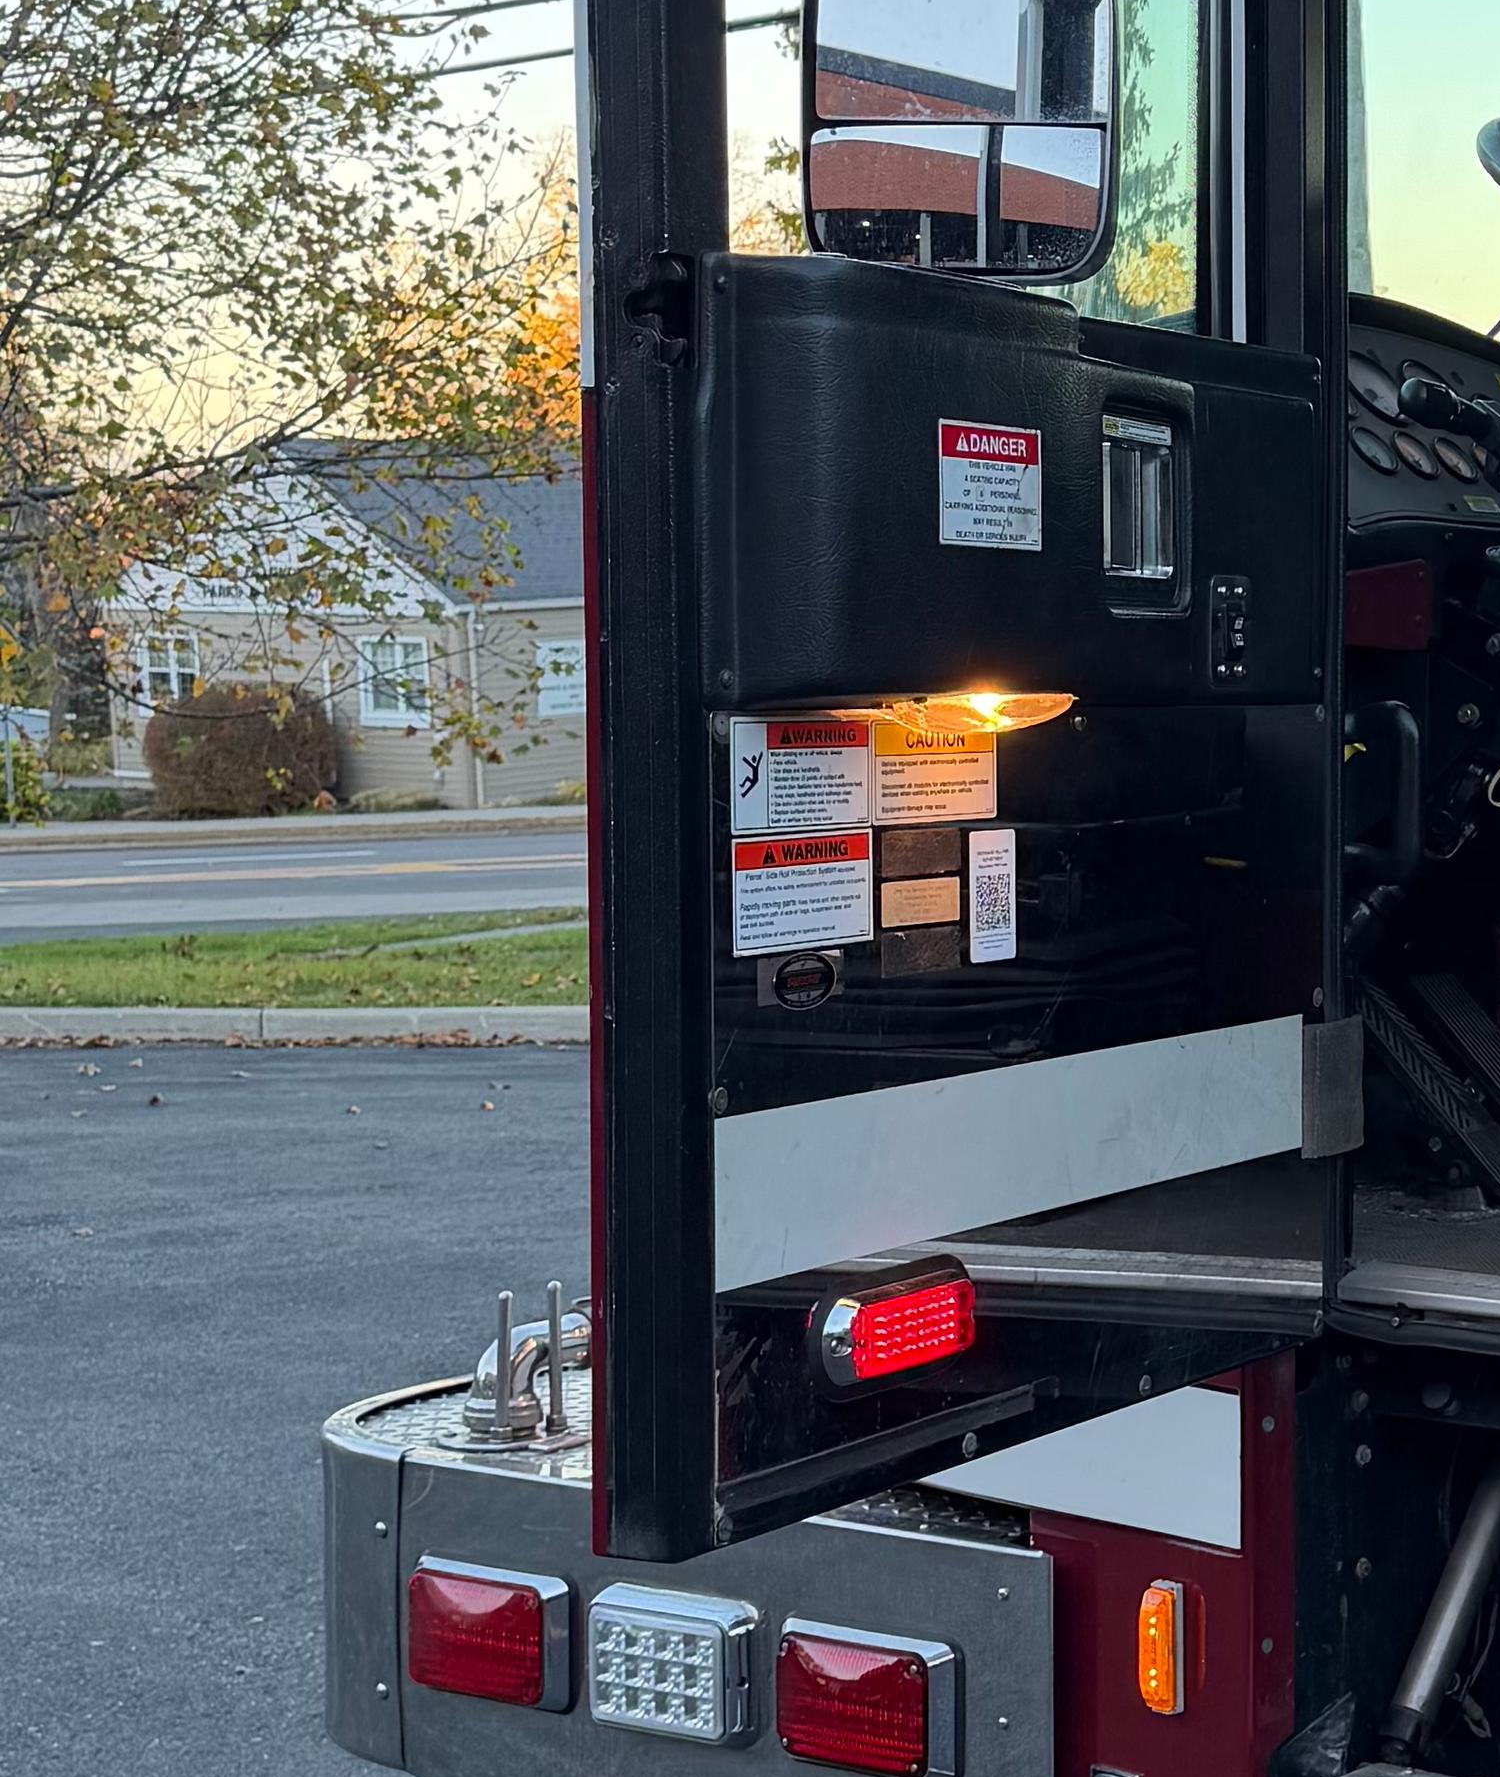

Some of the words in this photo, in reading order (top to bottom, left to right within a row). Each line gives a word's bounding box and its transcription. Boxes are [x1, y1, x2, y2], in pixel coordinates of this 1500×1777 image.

[970, 433, 1026, 457] DANGER
[792, 728, 857, 744] WARNING
[905, 731, 965, 749] CAUTION
[781, 840, 849, 862] WARNING
